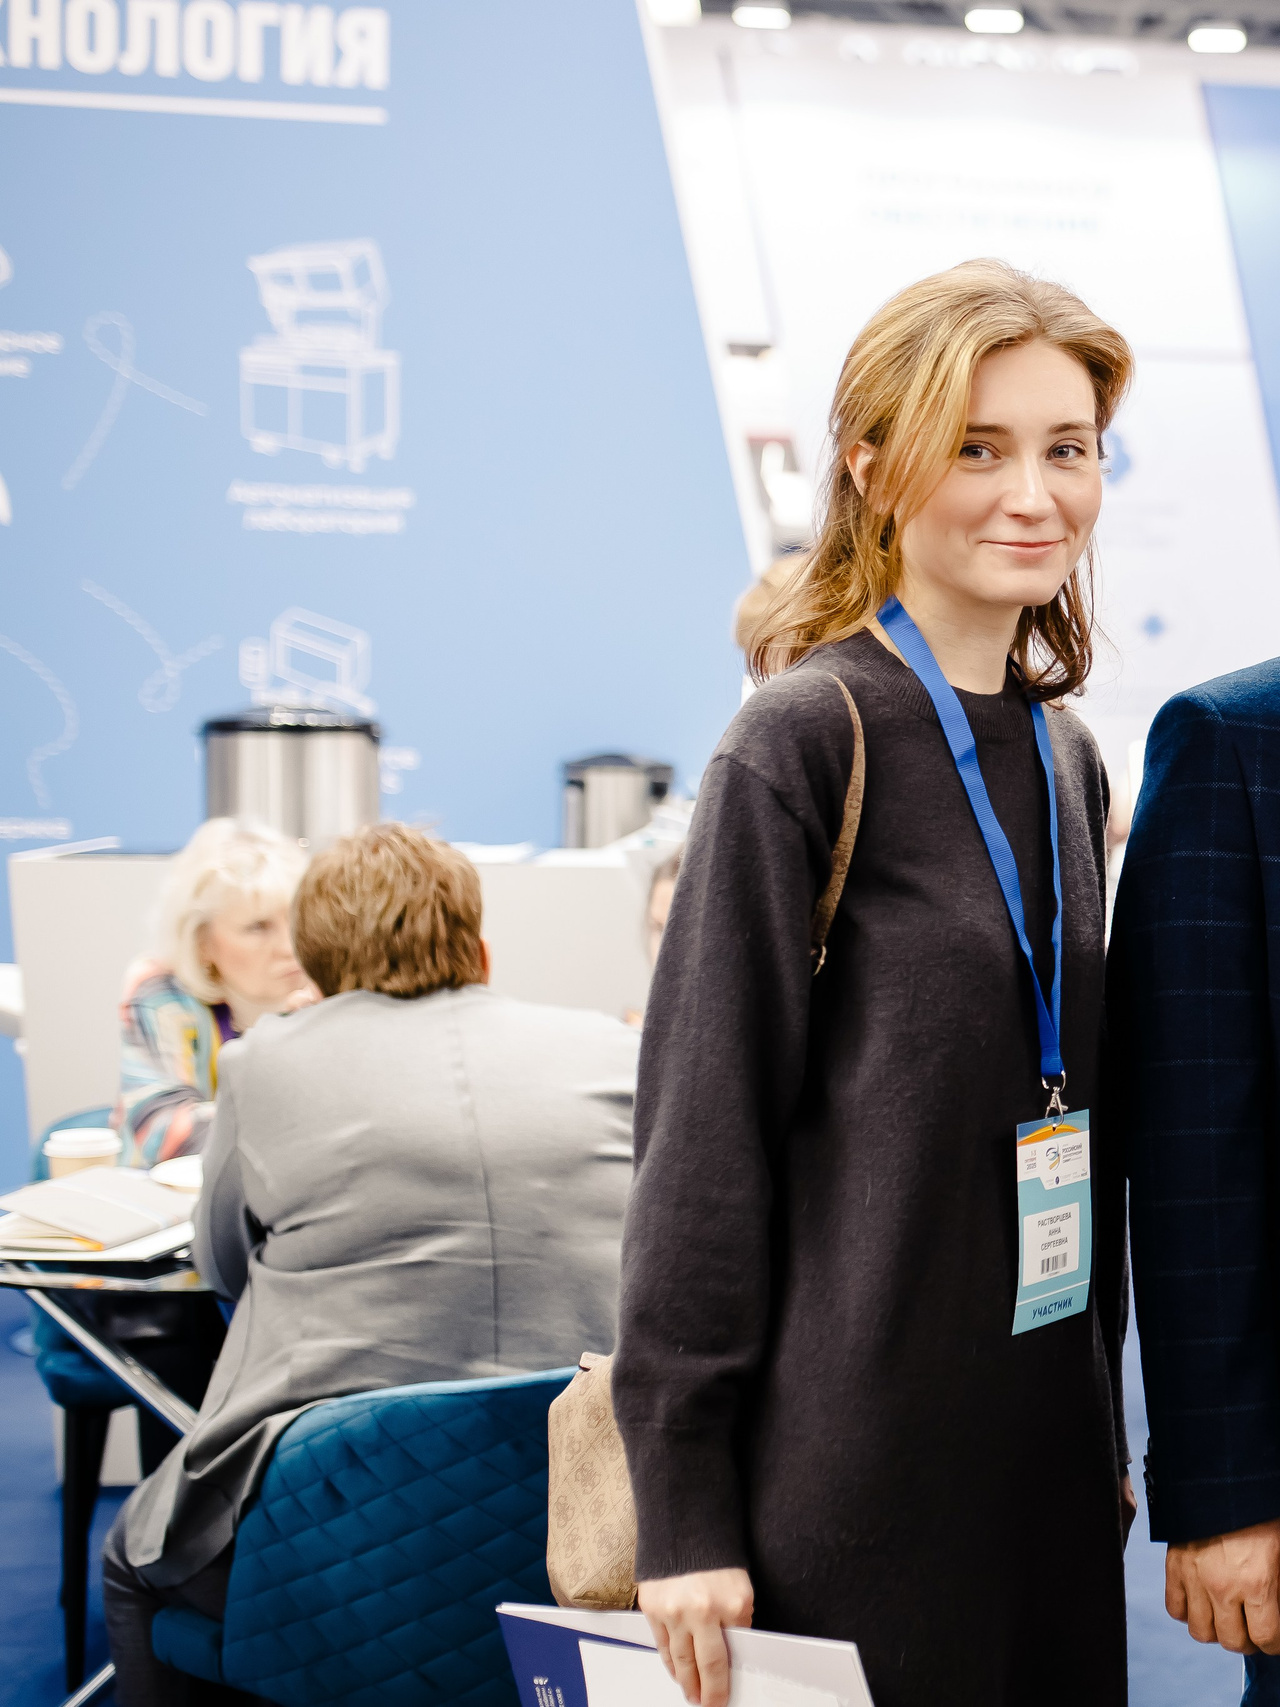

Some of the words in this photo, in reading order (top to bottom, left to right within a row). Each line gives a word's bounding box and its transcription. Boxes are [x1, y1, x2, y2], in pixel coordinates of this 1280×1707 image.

[0, 0, 390, 90] НОЛОГИЯ
[1037, 1211, 1072, 1228] РАСТВОРЦЕВА
[1048, 1226, 1062, 1237] АННА
[1040, 1237, 1069, 1252] СЕРГЕЕВНА
[1032, 1296, 1074, 1320] УЧАСТНИК
